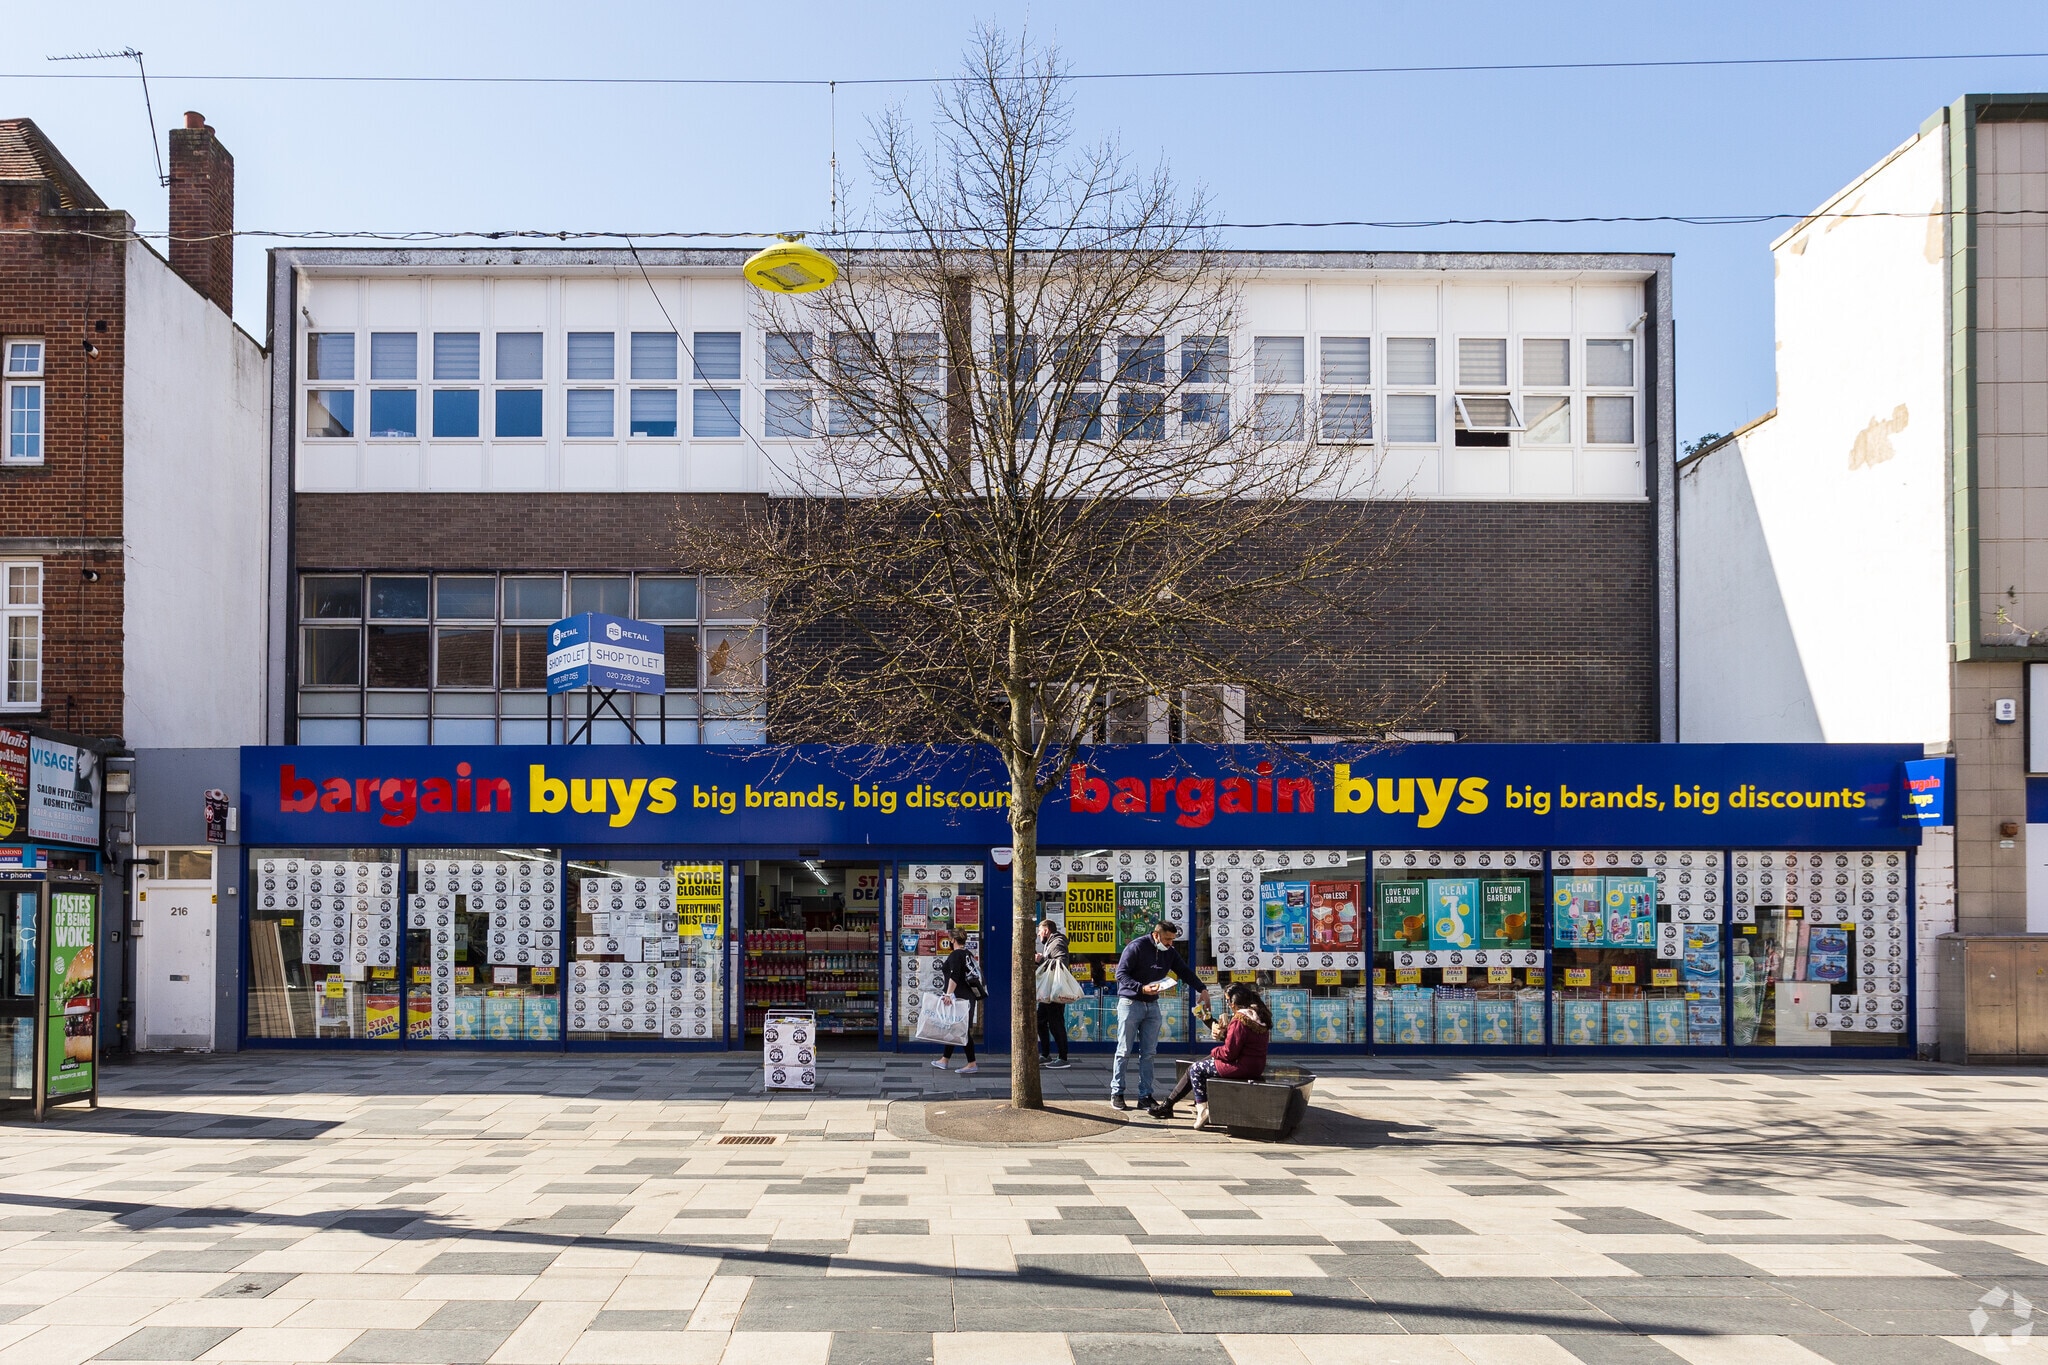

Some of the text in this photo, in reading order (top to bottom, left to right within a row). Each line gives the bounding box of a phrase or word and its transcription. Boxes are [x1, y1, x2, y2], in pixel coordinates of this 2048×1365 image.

[560, 628, 579, 638] RETAIL
[622, 630, 650, 642] RETAIL
[549, 649, 585, 670] SHOP TO LET
[596, 649, 660, 669] SHOP TO LET
[606, 671, 619, 679] 020
[620, 672, 635, 683] 7287
[32, 747, 74, 773] VISAGE
[37, 783, 56, 796] SALON
[1903, 776, 1940, 792] bargain
[280, 762, 1011, 828] bargain buys big brands, big discoun
[1070, 761, 1866, 828] bargain buys big brands, big discounts
[1909, 793, 1933, 807] buys
[43, 796, 85, 812] KOSMETYCZNY
[10, 872, 32, 880] phone
[677, 871, 721, 885] STORE
[677, 885, 721, 896] CLOSING!
[1260, 884, 1276, 892] ROLL
[1385, 887, 1420, 896] LOVE YOUR
[1439, 885, 1468, 896] CLEAN
[1486, 886, 1522, 895] LOVE YOUR
[1565, 882, 1594, 893] CLEAN
[1617, 883, 1646, 894] CLEAN
[1068, 888, 1113, 901] STORE
[1123, 890, 1157, 898] LOVE YOUR
[1261, 891, 1277, 899] ROLL
[1332, 891, 1348, 900] LESS!
[1486, 894, 1513, 902] GARDEN
[56, 895, 91, 912] TASTES
[1385, 896, 1411, 904] GARDEN
[170, 907, 188, 916] 216
[677, 903, 721, 914] EVERYTHING
[1068, 902, 1113, 913] CLOSING!
[55, 913, 90, 927] OF BEING
[678, 914, 704, 925] MUST
[1068, 920, 1113, 931] EVERYTHING
[55, 927, 91, 947] WOKE
[1068, 932, 1113, 943] MUST GO!
[1279, 995, 1300, 1003] CLEAN
[492, 1002, 512, 1011] CLEAN
[532, 1002, 551, 1010] CLEAN
[1070, 1003, 1090, 1011] CLEAN
[1319, 1003, 1339, 1012] CLEAN
[1403, 1005, 1424, 1013] CLEAN
[1445, 1005, 1467, 1013] CLEAN
[1484, 1005, 1506, 1014] CLEAN
[1573, 1006, 1594, 1014] CLEAN
[1615, 1006, 1637, 1014] CLEAN
[1656, 1005, 1678, 1013] CLEAN
[368, 1015, 395, 1030] STAR
[410, 1018, 432, 1031] STA
[367, 1022, 400, 1039] DEALS
